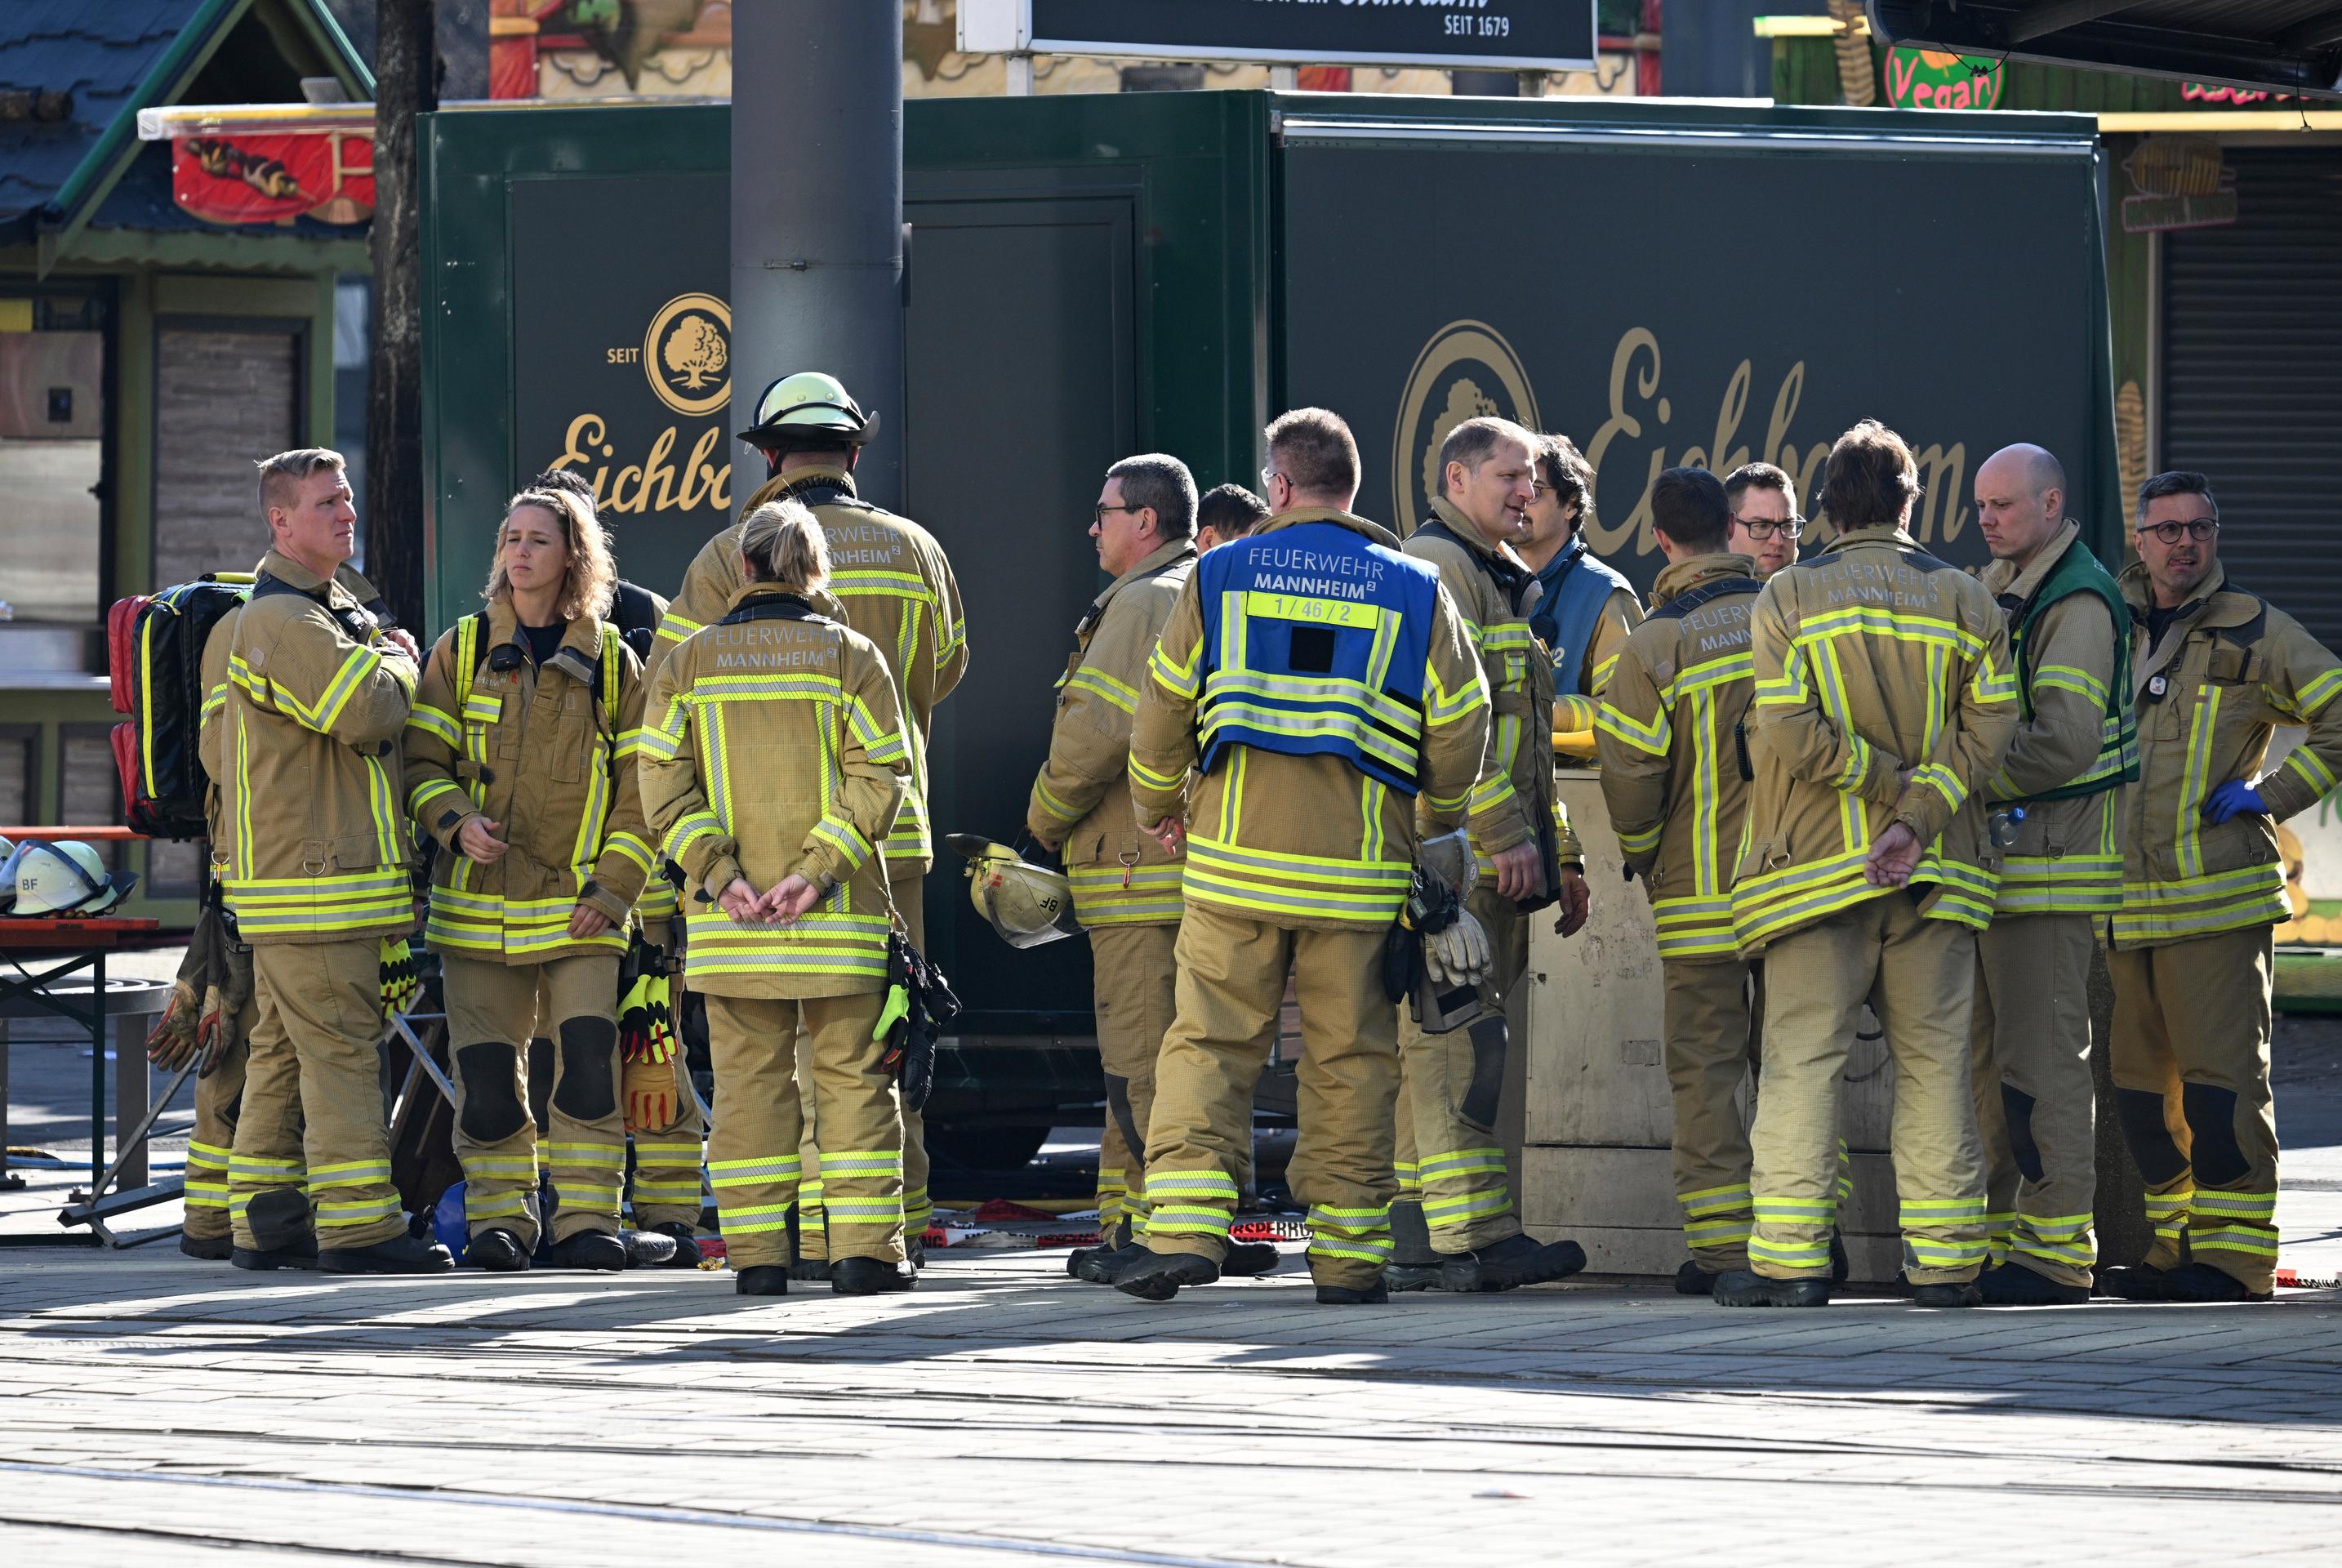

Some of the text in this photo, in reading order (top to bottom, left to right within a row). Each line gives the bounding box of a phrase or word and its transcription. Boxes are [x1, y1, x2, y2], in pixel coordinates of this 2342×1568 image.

[1444, 15, 1510, 37] SEIT 1679
[607, 348, 639, 363] SEIT
[824, 525, 902, 545] RWEHR
[1249, 548, 1385, 581] FEUERWEHR
[1808, 564, 1939, 592] FEUERWEHR
[702, 626, 841, 648] FEUERWEHR
[22, 878, 38, 890] BF
[1040, 897, 1059, 913] BF
